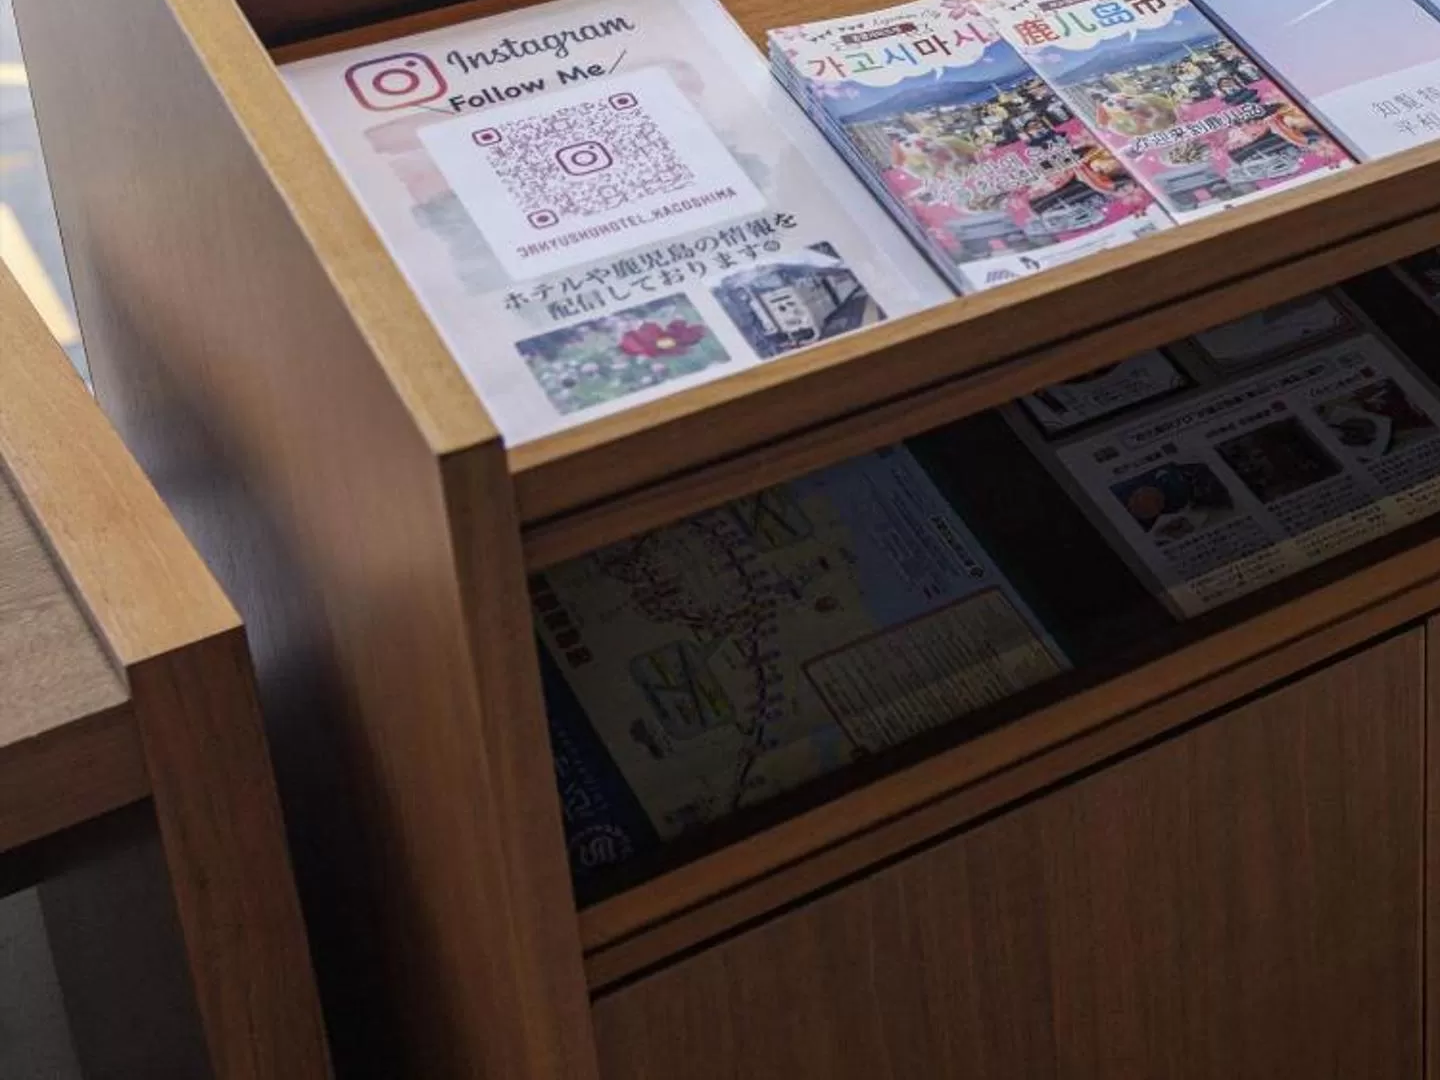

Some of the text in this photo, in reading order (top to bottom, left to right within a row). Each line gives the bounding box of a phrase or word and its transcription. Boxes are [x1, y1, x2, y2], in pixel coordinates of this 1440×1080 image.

[446, 12, 637, 75] Instagram
[806, 21, 993, 79] 가고시마시
[448, 59, 606, 114] Follow Me
[502, 211, 799, 312] ホテルや鹿児島の情報を
[547, 245, 763, 322] 配信しております
